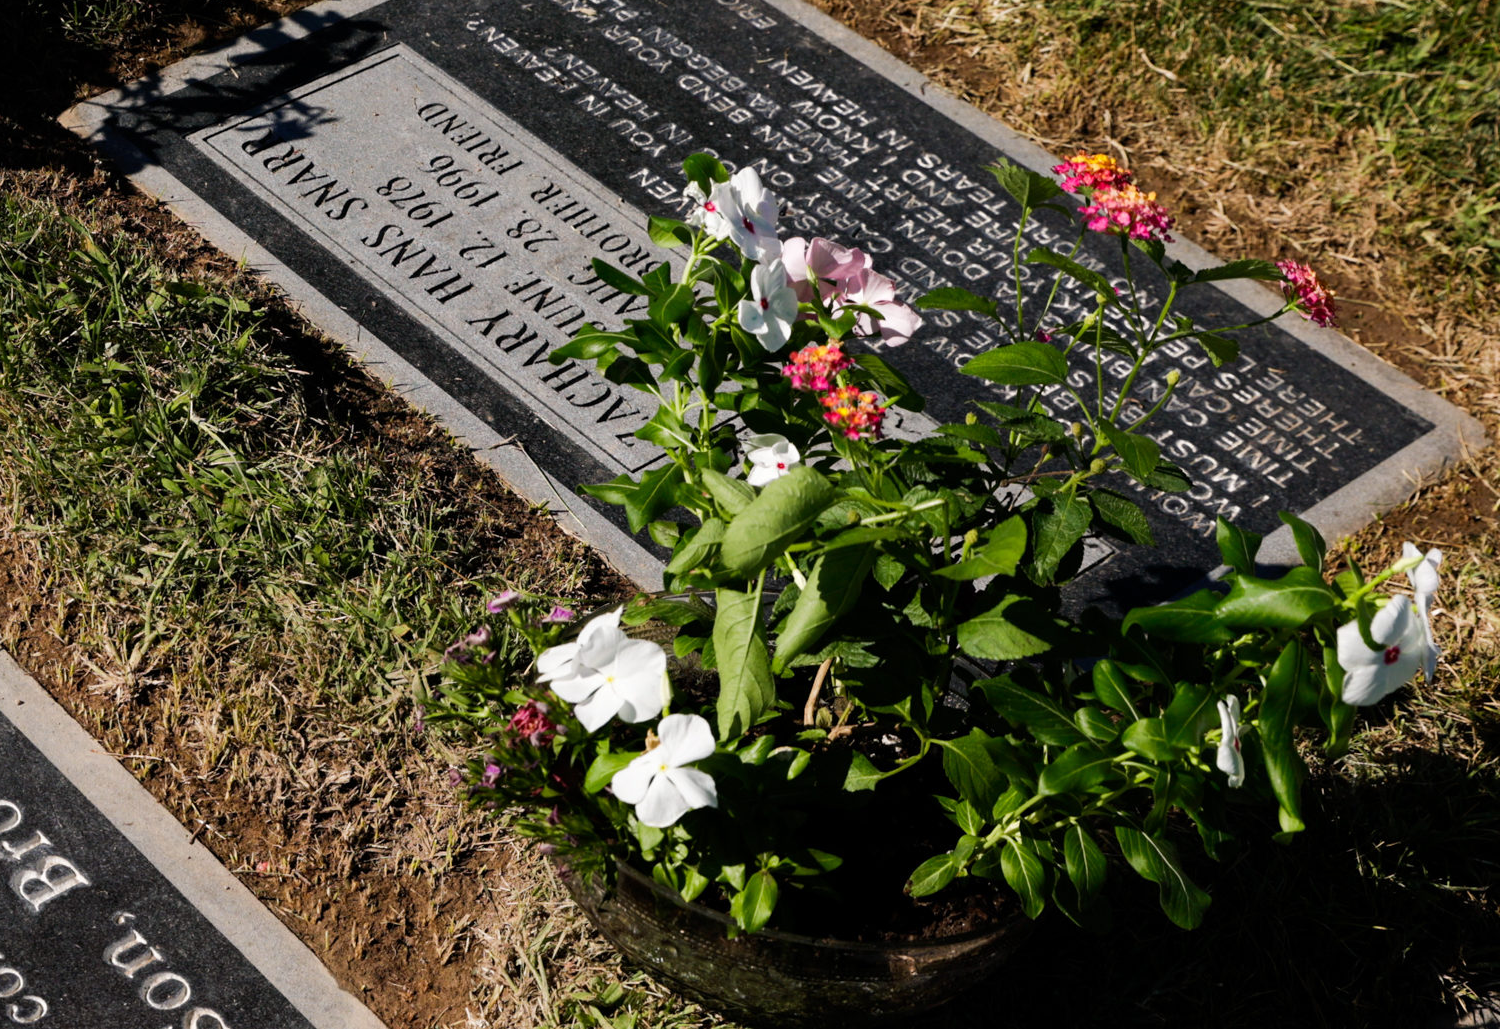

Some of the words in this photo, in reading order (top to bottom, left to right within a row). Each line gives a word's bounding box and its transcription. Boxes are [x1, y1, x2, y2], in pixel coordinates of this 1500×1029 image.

[600, 24, 672, 73] YOUR
[636, 25, 747, 92] BEGGIN'
[543, 45, 660, 121] HEAVEN?
[576, 93, 611, 117] IN
[676, 73, 753, 124] BEND
[748, 91, 781, 119] YA
[416, 102, 524, 176] FRIEND
[607, 118, 667, 158] YOU
[656, 121, 694, 145] IN
[750, 124, 813, 164] CAN
[783, 118, 860, 168] HAVE
[789, 99, 880, 154] KNOW
[876, 127, 914, 151] IN
[241, 128, 369, 222] SNARR
[423, 154, 500, 208] 1996
[746, 156, 796, 187] ON
[813, 165, 884, 215] TIME
[900, 168, 965, 206] AND
[915, 151, 1007, 215] TEARS
[374, 175, 454, 229] 1978
[801, 191, 894, 255] CARRY
[359, 223, 475, 305] HANS
[965, 210, 1048, 265] URE
[1013, 215, 1103, 275] MORE
[895, 255, 952, 294] ND
[965, 237, 1048, 293] YOUR
[1107, 275, 1157, 309] NO
[503, 270, 609, 340] JUNE
[1105, 301, 1207, 369] PEACE
[1097, 390, 1145, 424] BE
[1137, 380, 1209, 430] CAN
[1213, 371, 1340, 460] THERES
[1229, 354, 1366, 444] THERE'L
[1144, 428, 1247, 493] MUST
[1213, 430, 1294, 489] TIME
[1235, 416, 1317, 474] TIME
